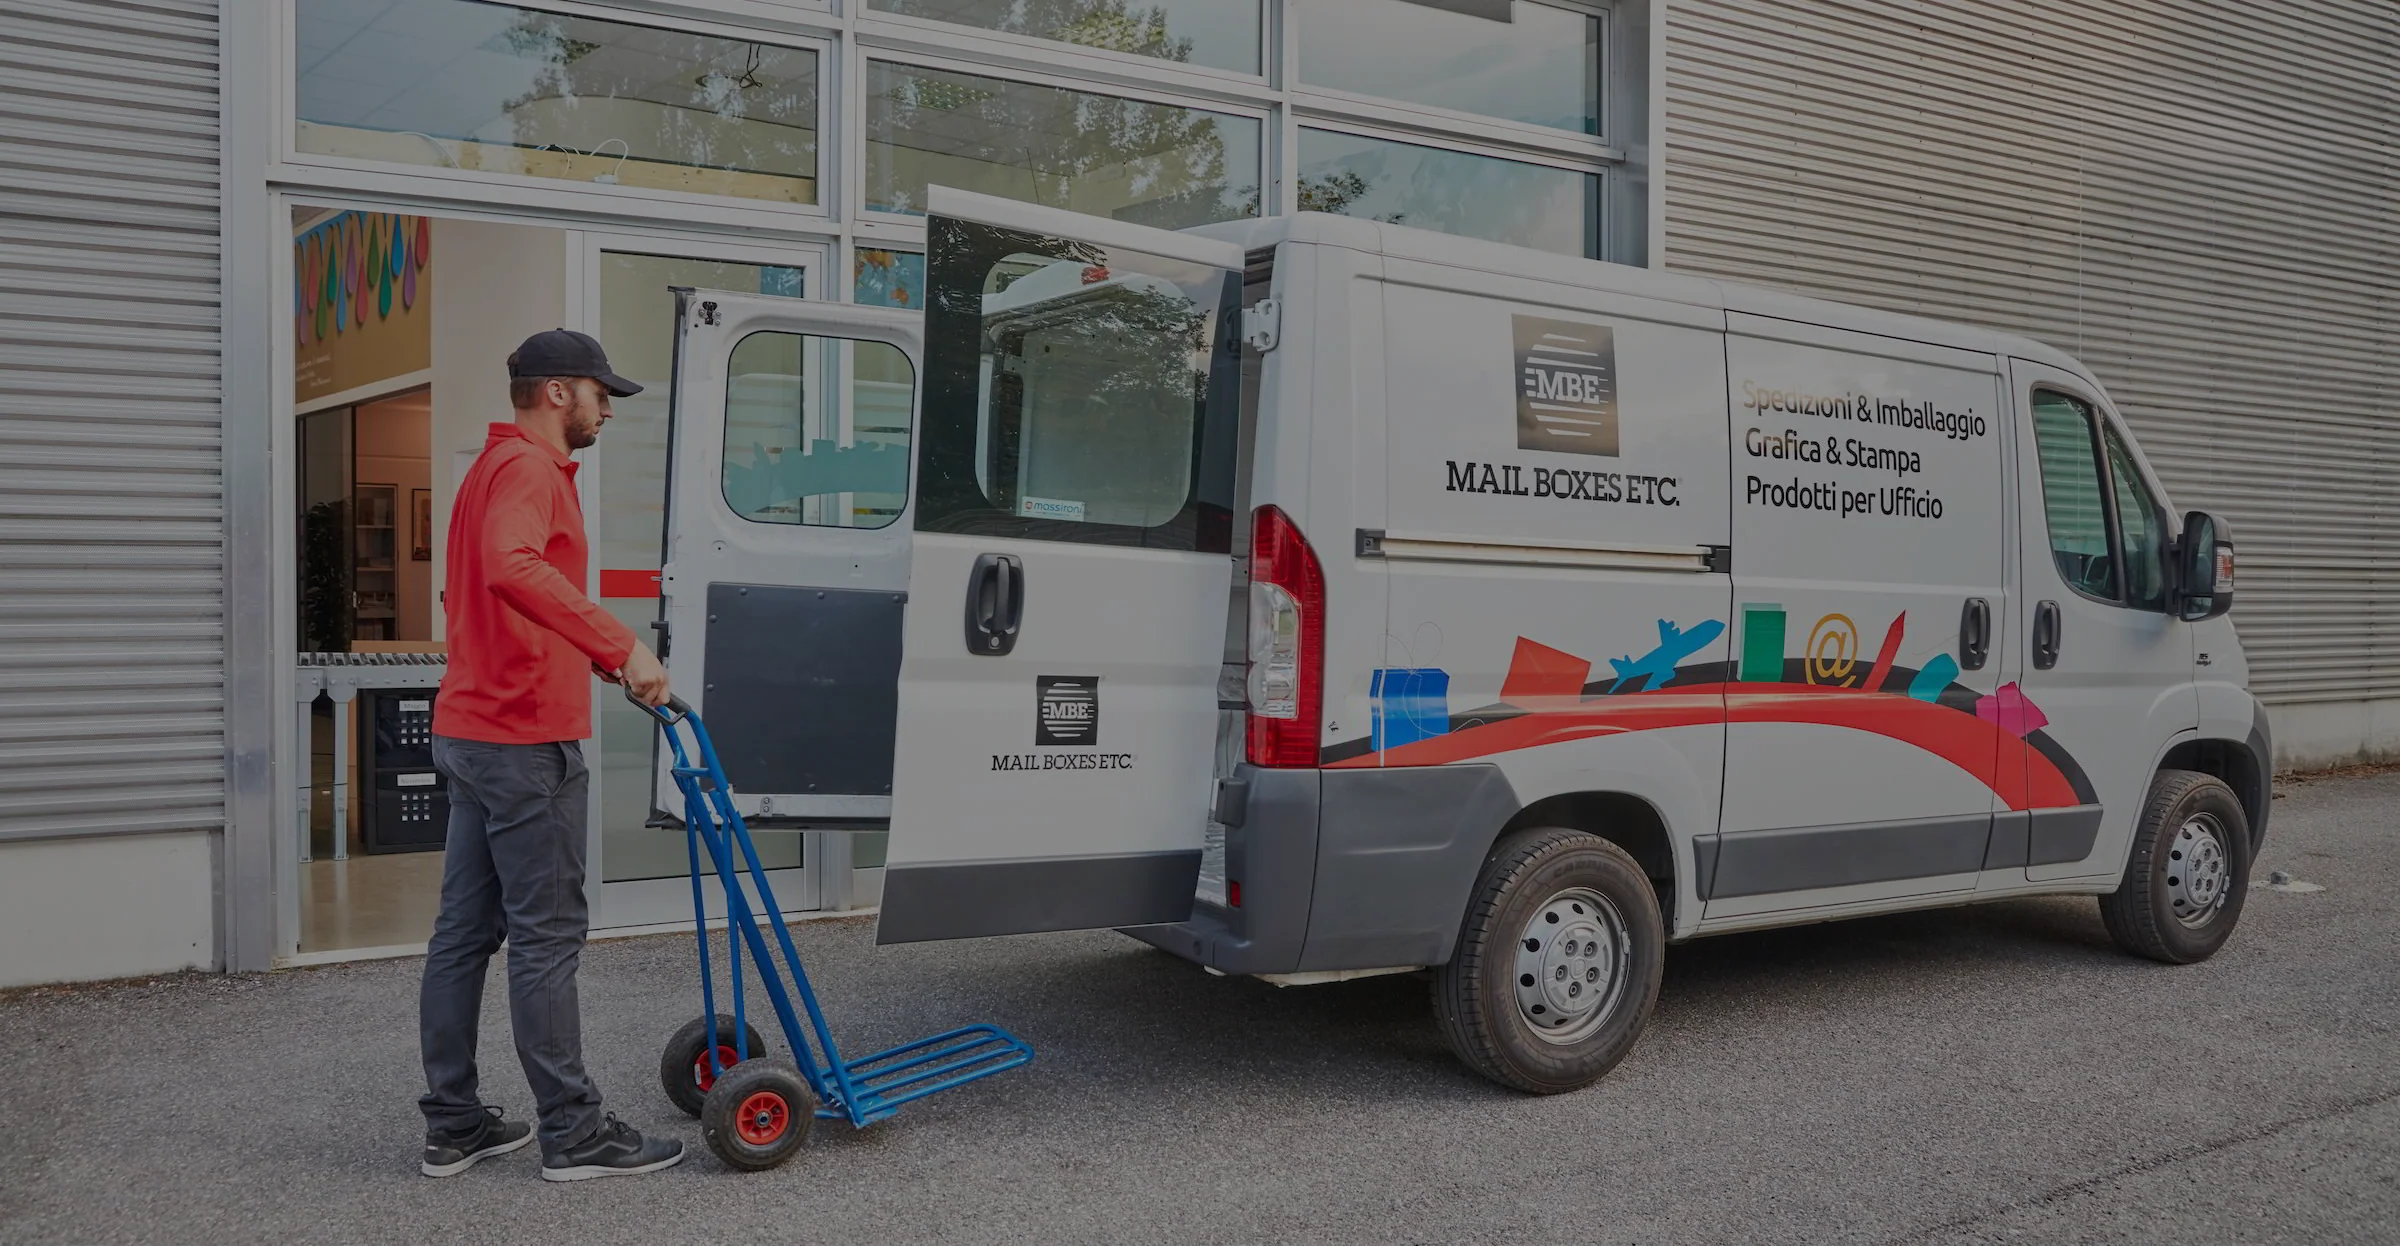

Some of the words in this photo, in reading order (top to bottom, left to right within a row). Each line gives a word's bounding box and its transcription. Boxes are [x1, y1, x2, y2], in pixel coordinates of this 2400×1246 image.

[1535, 369, 1600, 404] MBE
[1742, 379, 1852, 420] Spedizioni
[1857, 395, 1873, 423] &
[1876, 397, 1986, 441] Imballaggio
[1745, 427, 1821, 462] Grafica
[1826, 436, 1842, 465] &
[1846, 438, 1921, 477] Stampa
[1446, 460, 1529, 496] MAIL
[1533, 467, 1622, 502] BOXES
[1625, 475, 1680, 507] ETC.
[1747, 475, 1836, 512] Prodotti
[1842, 489, 1876, 519] per
[1880, 486, 1943, 519] Ufficio
[1049, 702, 1089, 720] MBE
[991, 755, 1040, 771] MAIL
[1043, 754, 1097, 770] BOXES
[1098, 753, 1133, 769] ETC.
